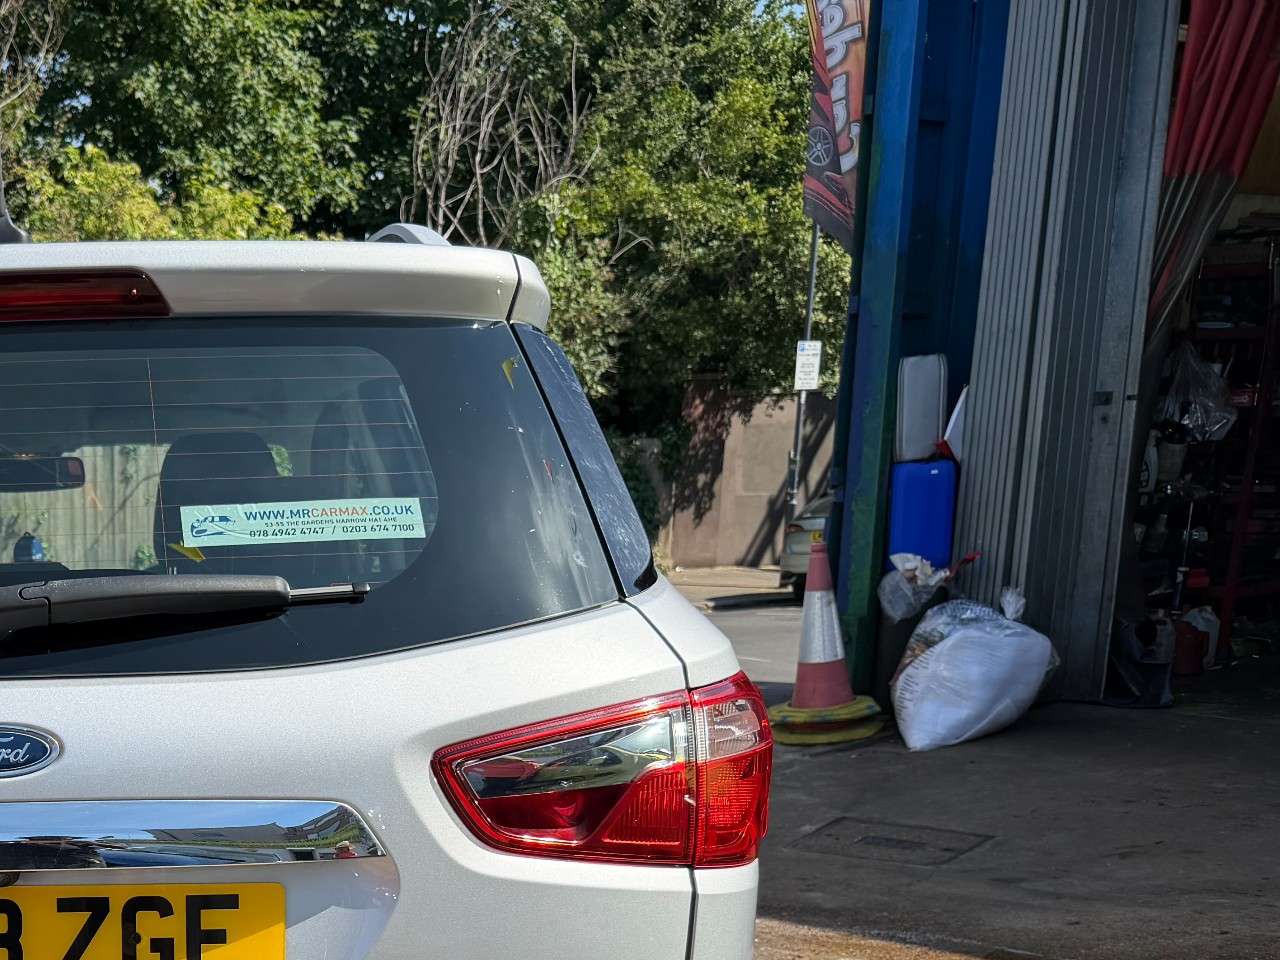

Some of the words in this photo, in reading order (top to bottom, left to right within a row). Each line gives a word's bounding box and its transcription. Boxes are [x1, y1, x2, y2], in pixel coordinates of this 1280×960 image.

[244, 504, 414, 521] WWW.MRCARMAX.CO.UK
[249, 529, 269, 538] 078
[271, 528, 297, 537] 4942
[300, 526, 325, 535] 4747
[342, 525, 367, 533] 0203
[391, 523, 415, 532] 7100
